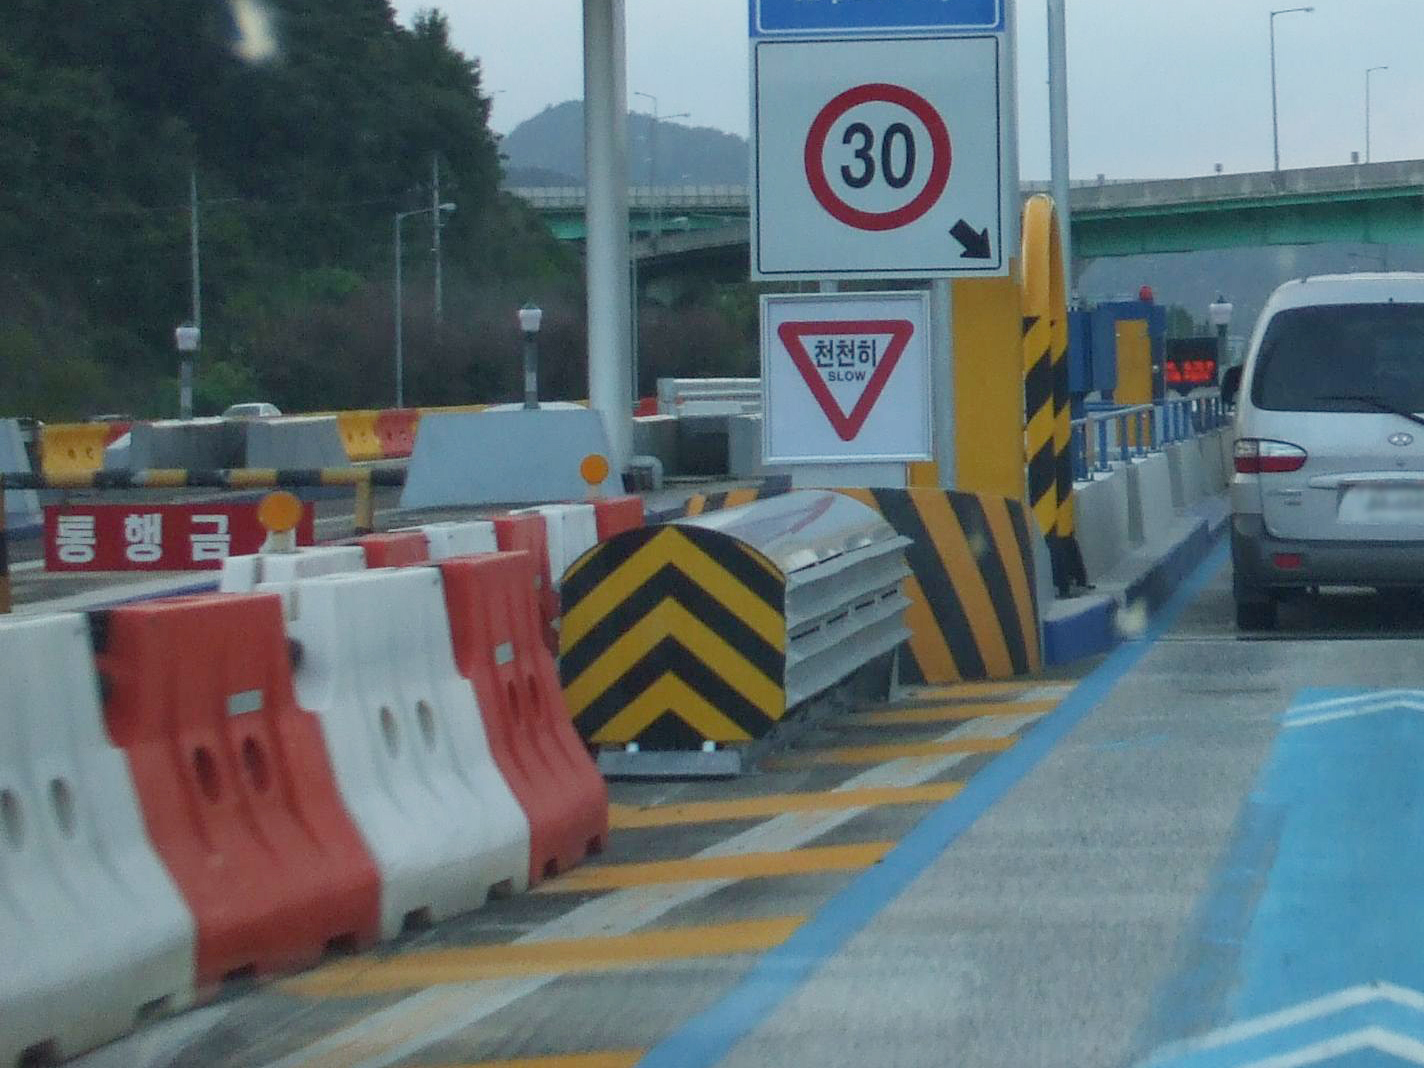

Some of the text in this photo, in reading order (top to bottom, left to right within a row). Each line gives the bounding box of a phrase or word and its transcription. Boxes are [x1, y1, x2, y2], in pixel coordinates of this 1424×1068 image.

[840, 122, 917, 190] 30
[814, 339, 877, 368] 천천히
[828, 370, 867, 382] SLOW
[55, 513, 231, 564] 통행금
